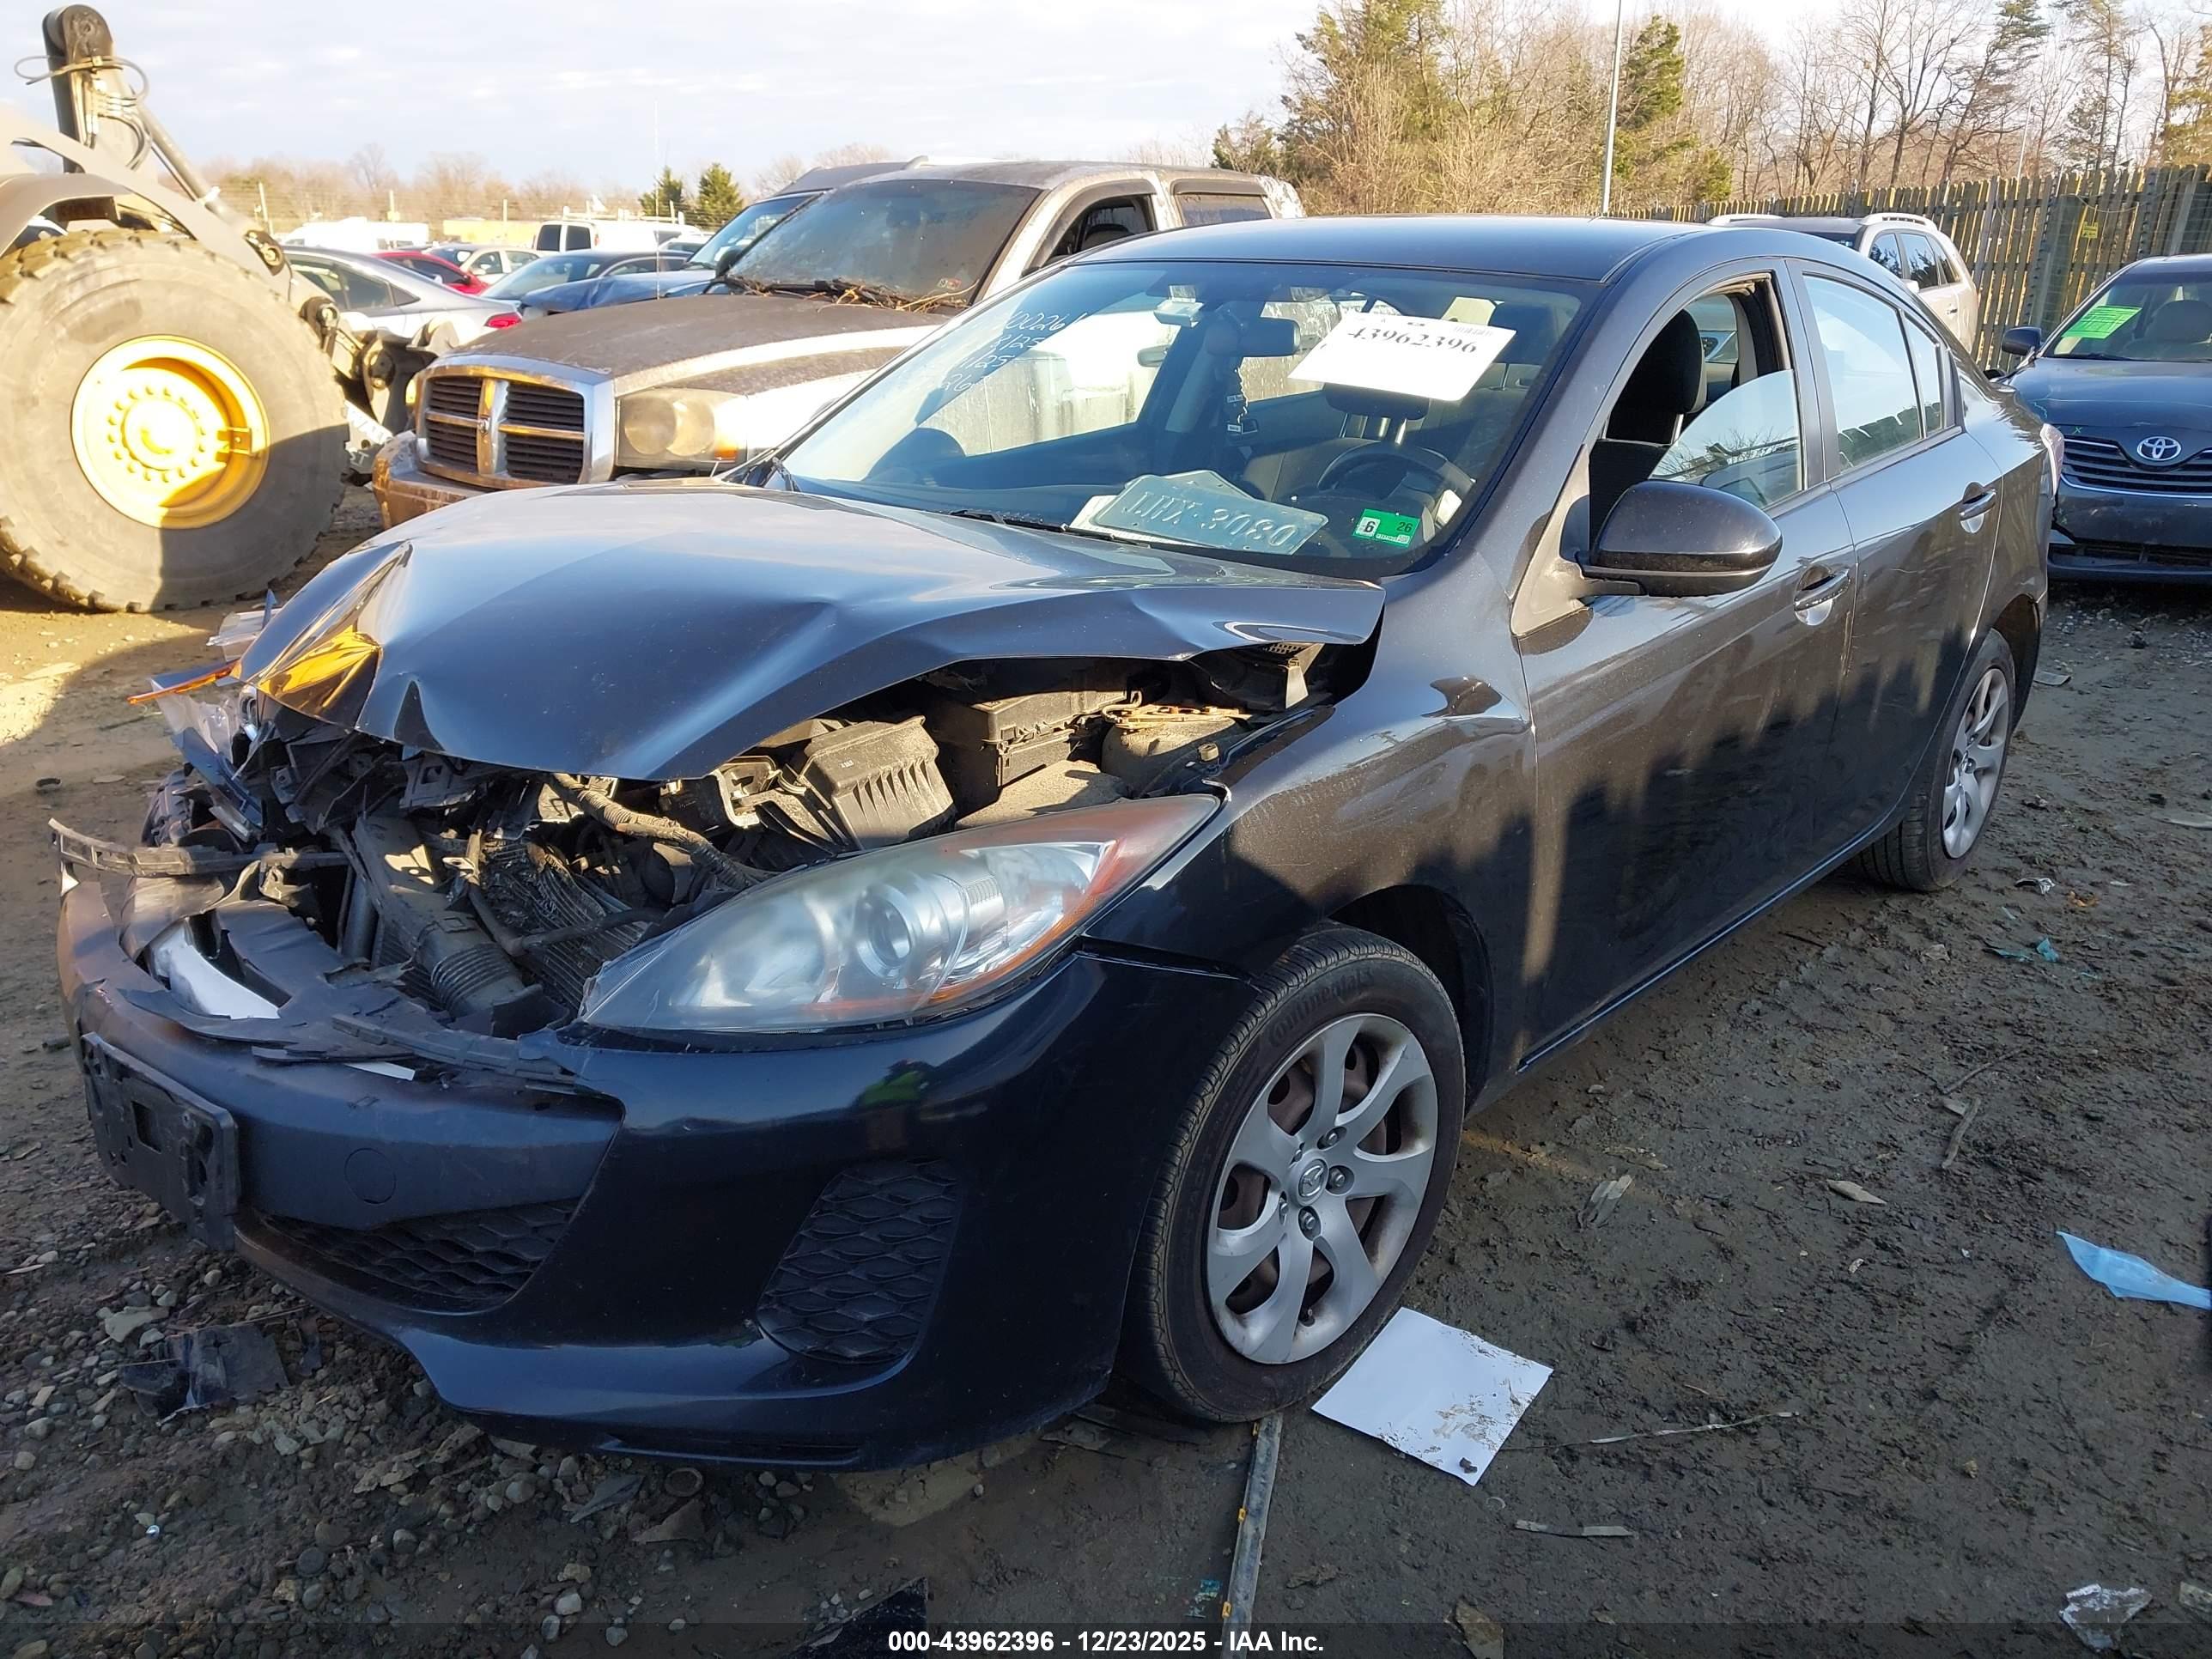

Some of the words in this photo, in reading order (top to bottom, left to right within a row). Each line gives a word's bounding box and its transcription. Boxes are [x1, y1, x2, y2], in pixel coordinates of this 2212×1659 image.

[1347, 326, 1479, 354] 43962396
[1364, 520, 1376, 533] 6
[1396, 521, 1413, 533] 26
